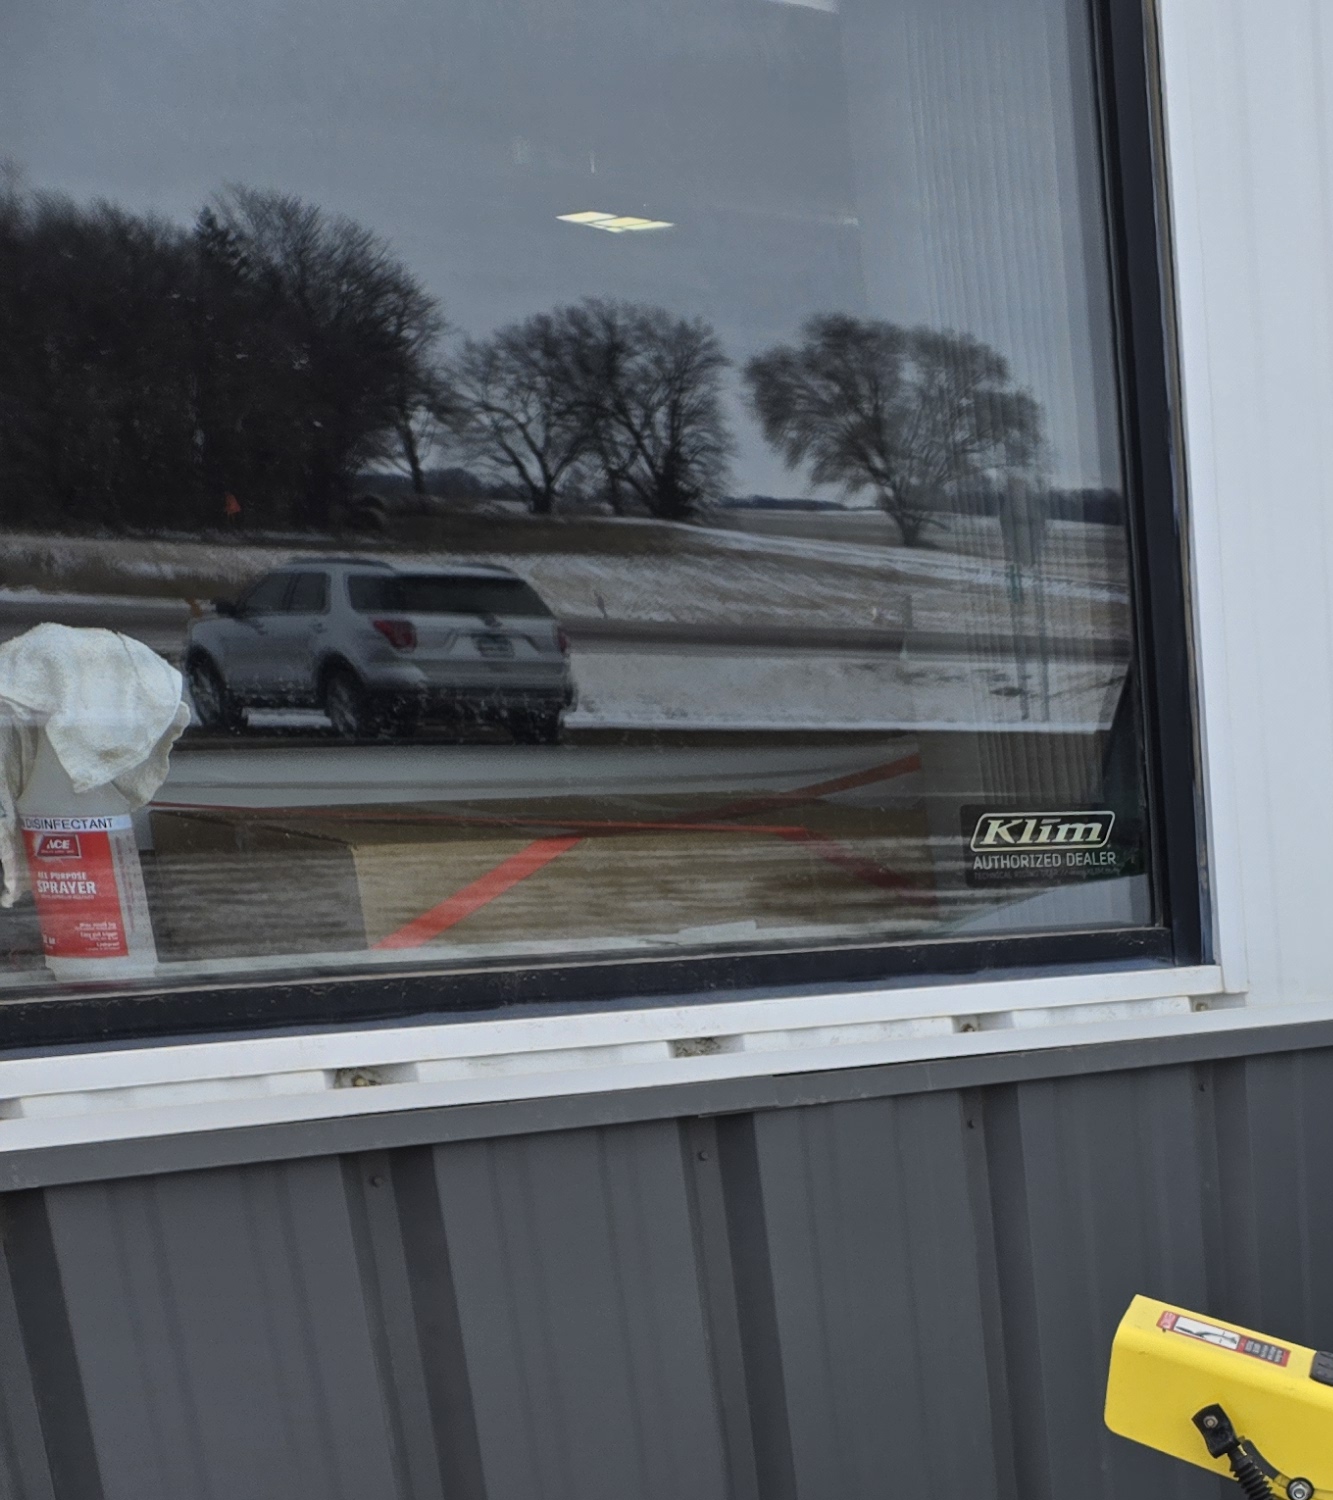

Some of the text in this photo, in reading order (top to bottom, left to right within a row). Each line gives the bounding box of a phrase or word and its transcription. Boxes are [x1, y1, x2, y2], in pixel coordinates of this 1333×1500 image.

[25, 817, 114, 830] DISINFECTANT
[46, 839, 71, 849] ACE
[973, 852, 1117, 870] AUTHORIZED DEALER
[50, 871, 87, 880] PURPOSE
[36, 880, 97, 894] SPRAYER
